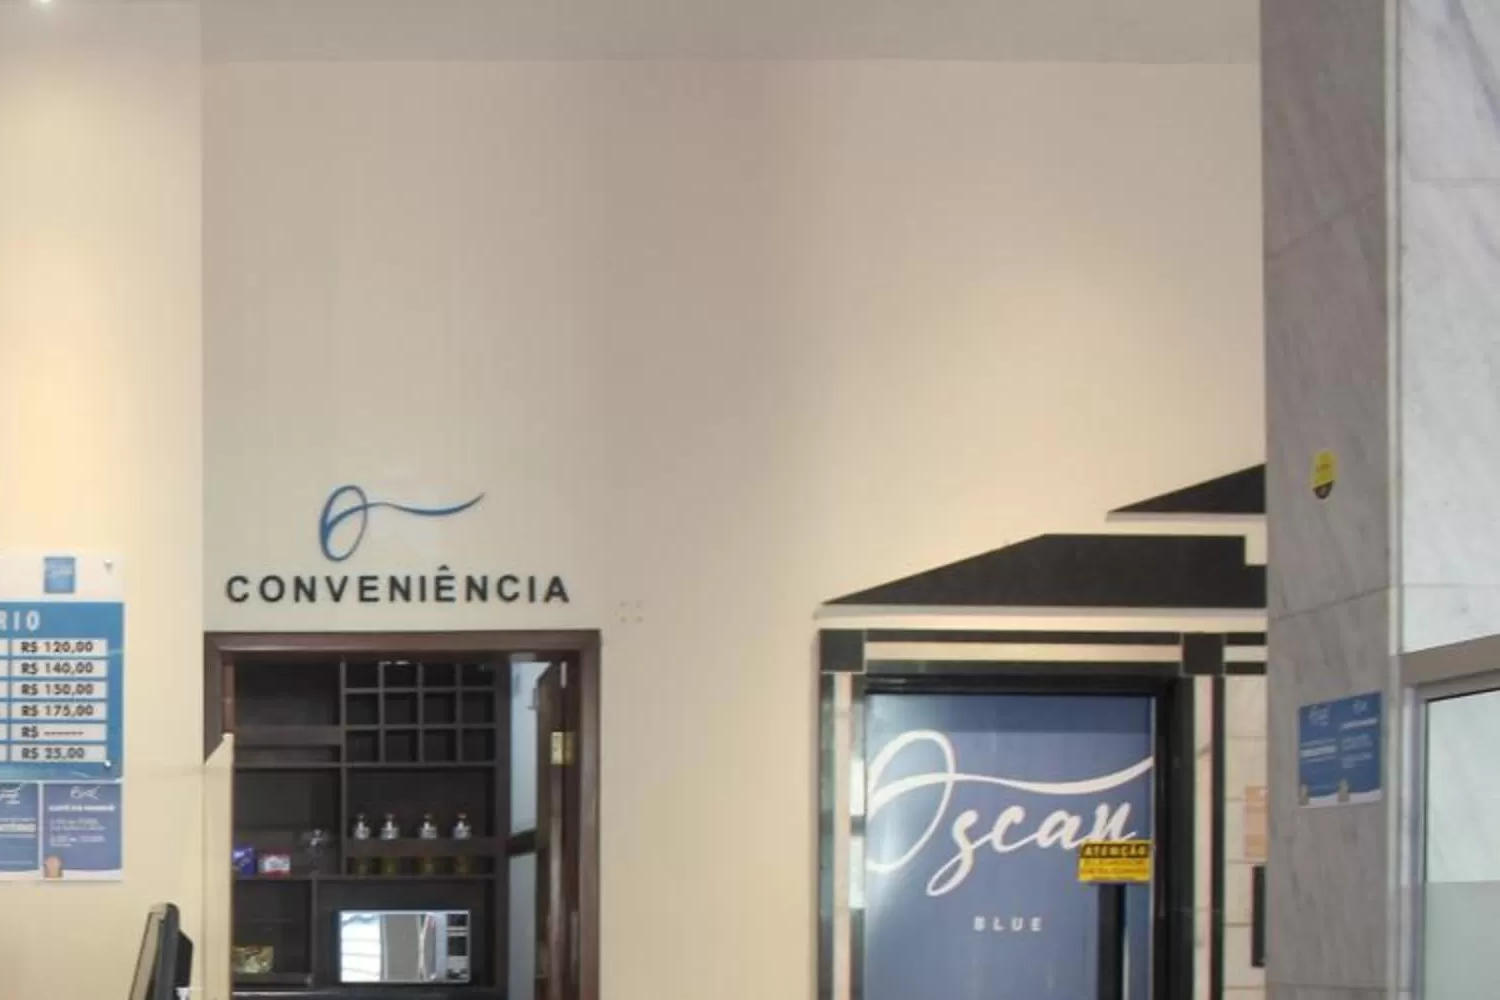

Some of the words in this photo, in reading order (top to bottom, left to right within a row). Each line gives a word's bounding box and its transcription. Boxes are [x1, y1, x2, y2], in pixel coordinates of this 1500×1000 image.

[226, 564, 570, 603] CONVENIÊNCIA
[44, 641, 94, 654] 120,00
[44, 662, 94, 675] 140,00
[44, 683, 94, 697] 150,00
[44, 704, 94, 717] 175,00
[972, 916, 1043, 932] BLUE
